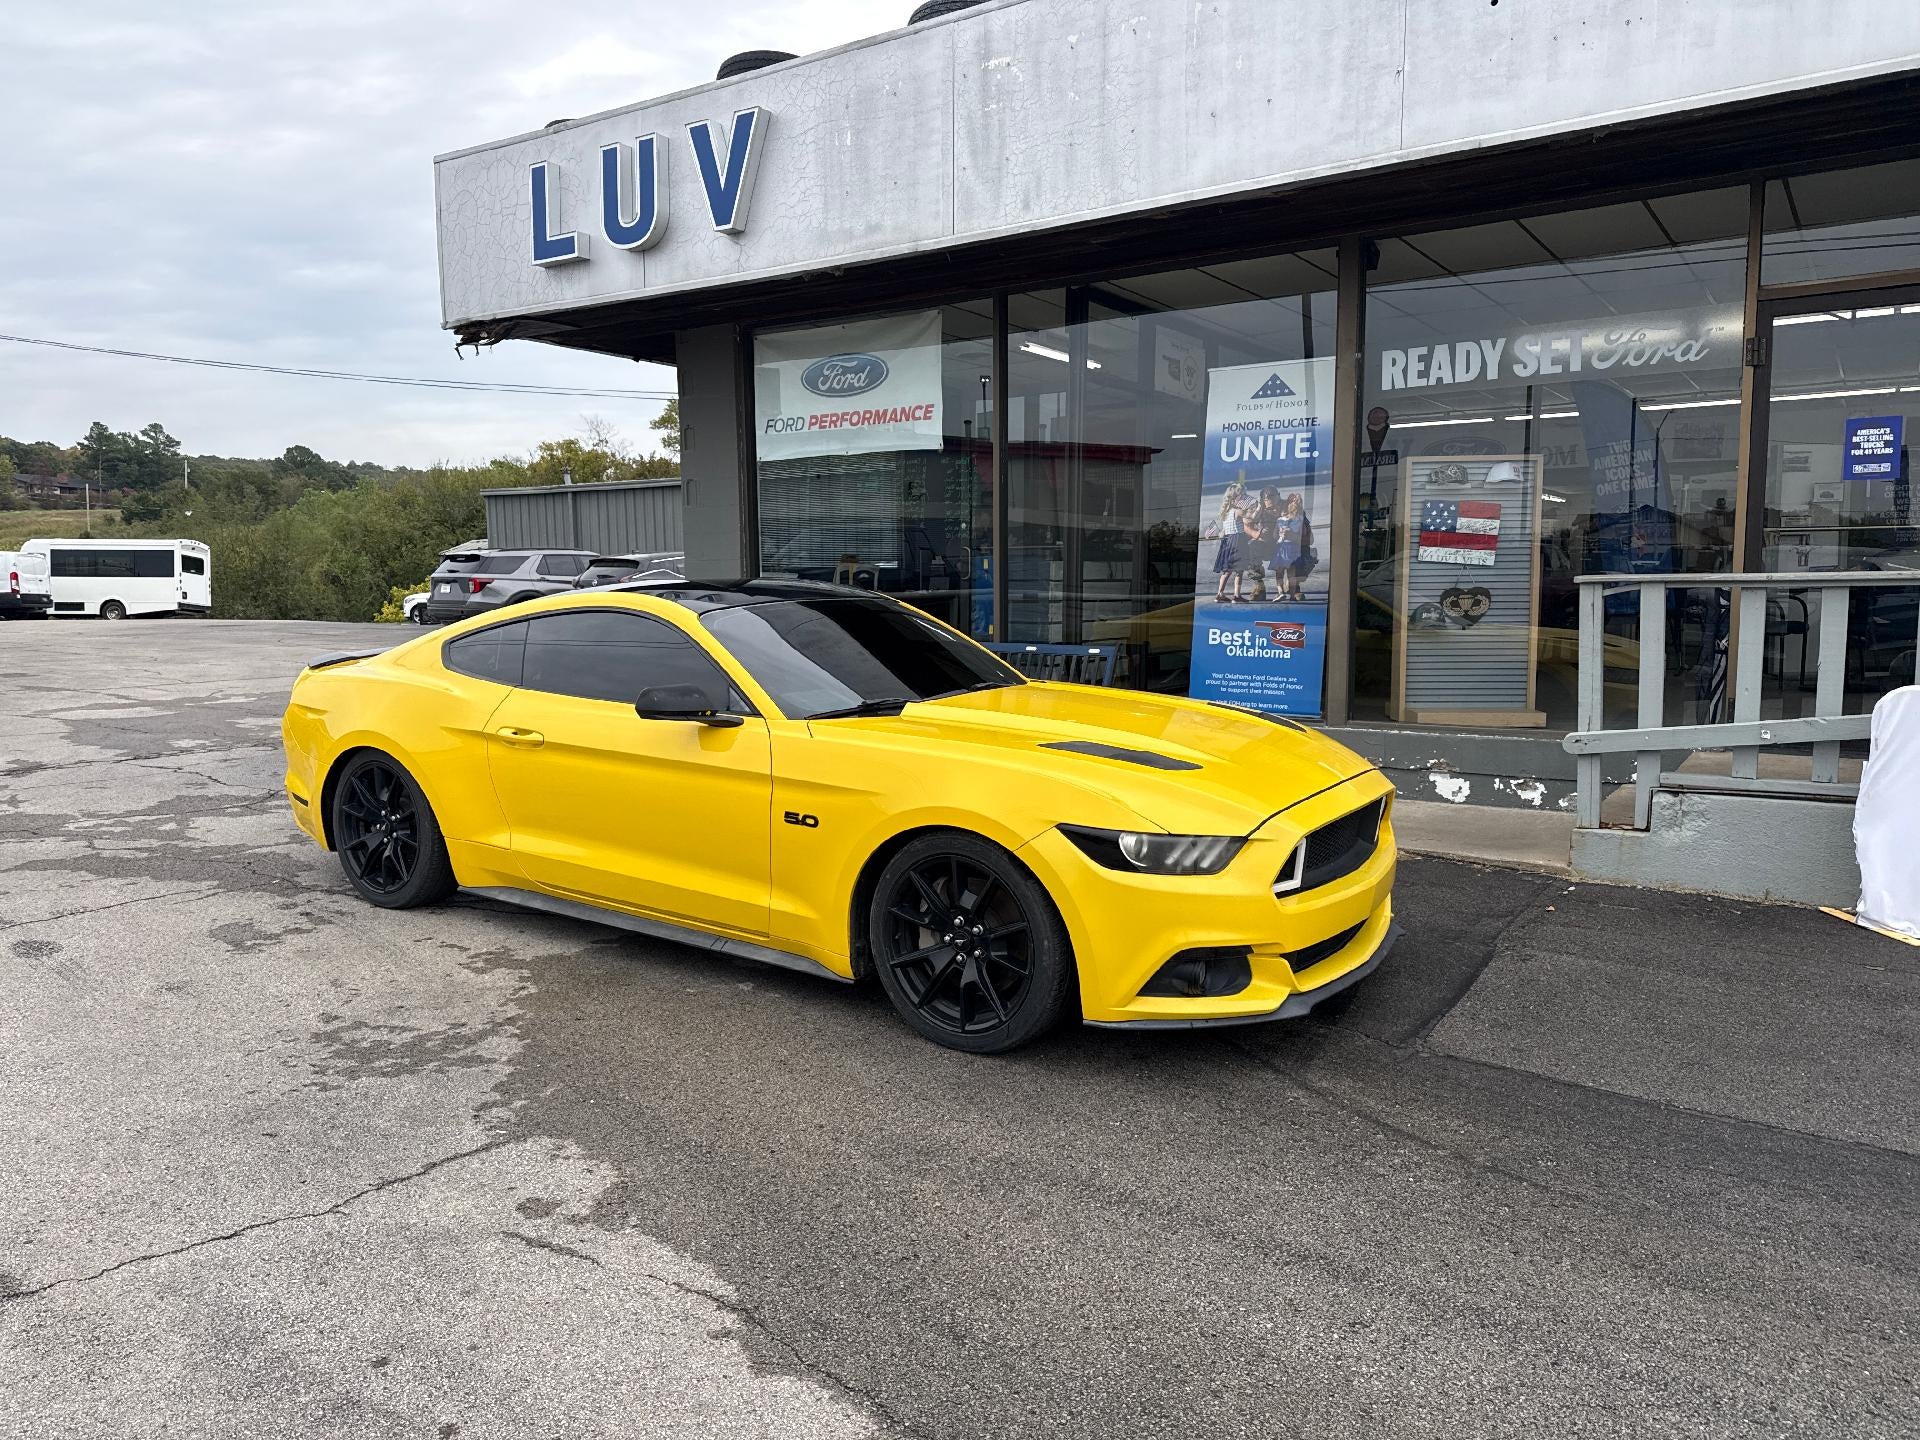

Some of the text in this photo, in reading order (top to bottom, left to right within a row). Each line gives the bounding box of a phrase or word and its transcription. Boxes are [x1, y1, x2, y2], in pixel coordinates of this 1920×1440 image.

[1381, 337, 1507, 391] READY
[1512, 328, 1590, 378] SET
[1590, 327, 1714, 370] Ford
[817, 361, 871, 391] Ford
[765, 403, 935, 434] FORD PERFORMANCE
[1222, 417, 1321, 432] HONOR. EDUCATE.
[1852, 434, 1894, 443] BEST-SELLING
[1856, 427, 1891, 436] AMERICA'S
[1220, 432, 1320, 462] UNITE.
[1860, 441, 1885, 449] TRUCKS
[1873, 447, 1894, 455] YEARS
[1594, 448, 1652, 471] AMERIAN
[1596, 481, 1620, 496] ONE
[1208, 628, 1300, 647] Best in Ford
[1226, 645, 1291, 659] Oklahoma
